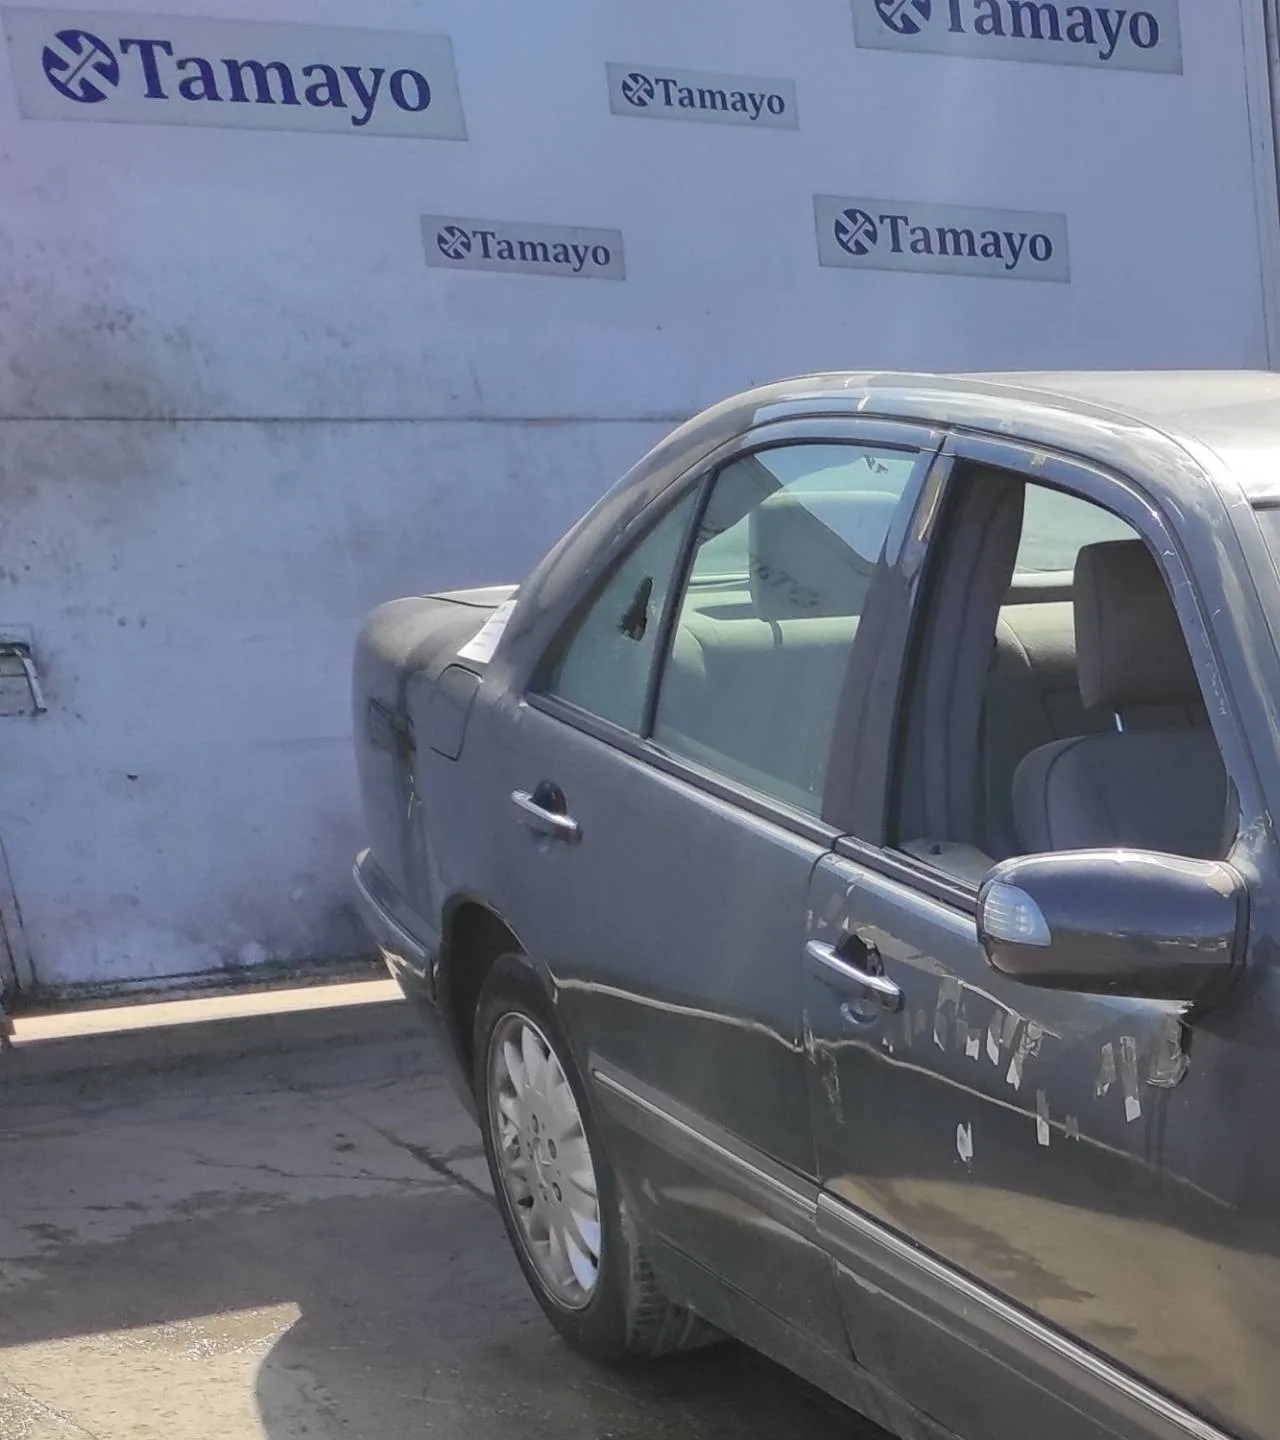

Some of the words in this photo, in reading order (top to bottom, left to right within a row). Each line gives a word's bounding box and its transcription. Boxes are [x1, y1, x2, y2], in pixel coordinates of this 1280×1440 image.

[948, 0, 1160, 59] Tamayo
[119, 39, 431, 126] Tamayo
[655, 78, 784, 120] Tamayo
[472, 231, 610, 272] Tamayo
[879, 215, 1052, 270] Tamayo
